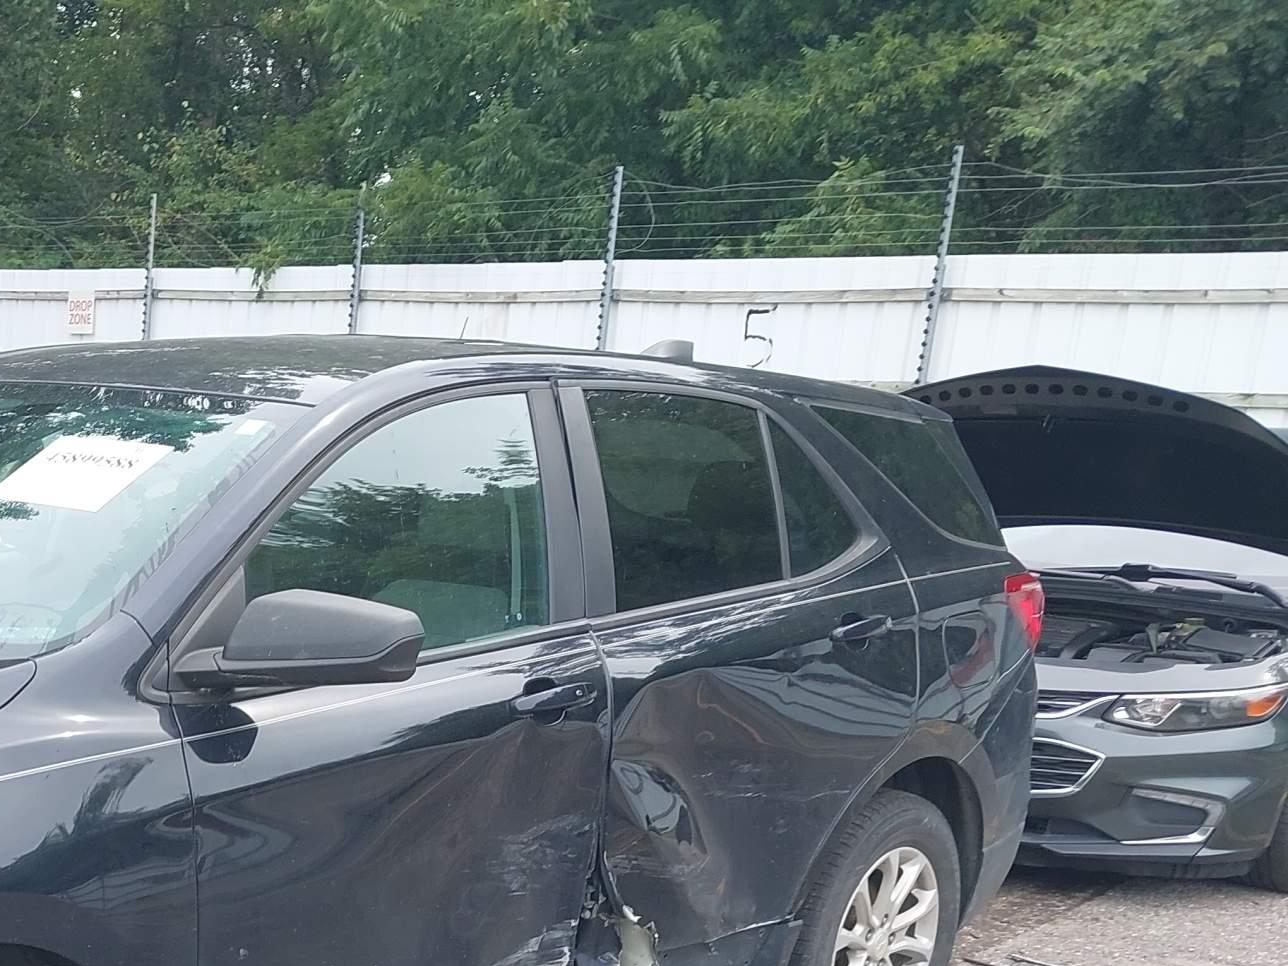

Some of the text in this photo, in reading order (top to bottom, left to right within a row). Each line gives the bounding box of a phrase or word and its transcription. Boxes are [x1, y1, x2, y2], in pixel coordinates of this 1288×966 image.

[69, 300, 92, 311] DROP
[69, 313, 92, 324] ZONE
[744, 303, 778, 368] 5
